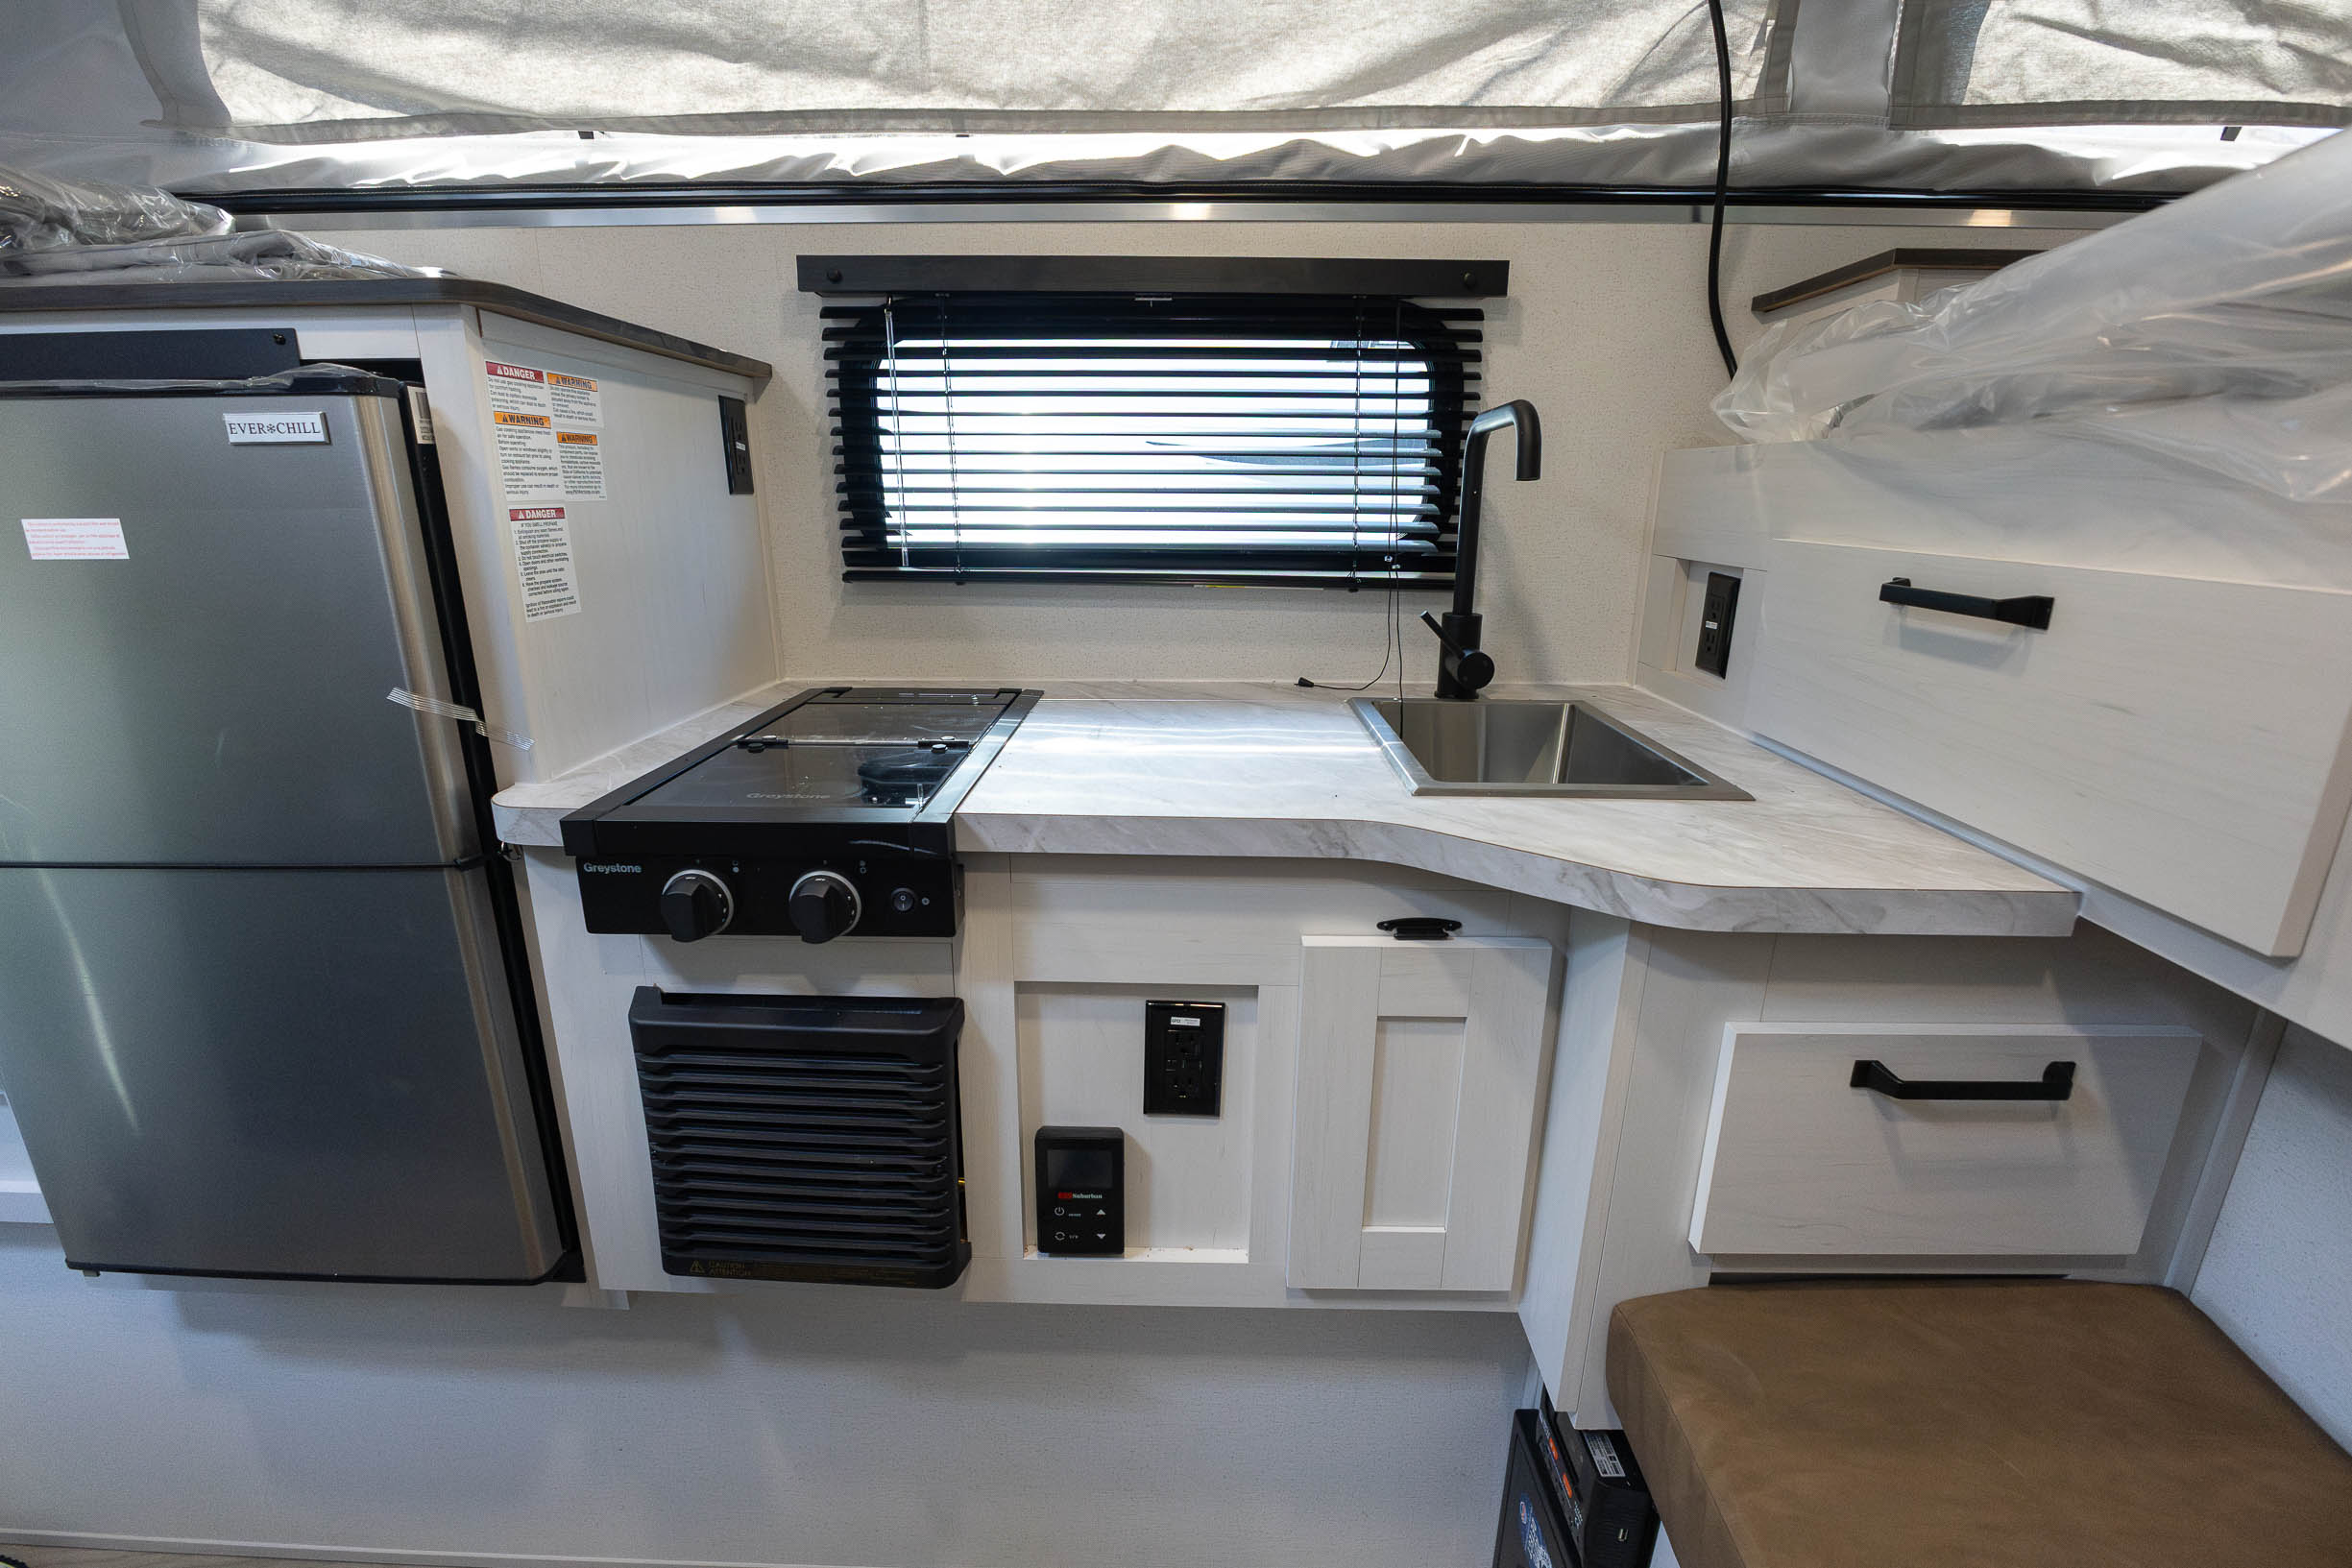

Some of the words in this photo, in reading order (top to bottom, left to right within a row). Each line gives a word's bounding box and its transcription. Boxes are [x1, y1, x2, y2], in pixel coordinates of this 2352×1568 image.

[503, 366, 535, 380] DANGER
[561, 376, 592, 389] WARNING
[508, 415, 545, 425] WARNING
[230, 423, 268, 435] EVER
[276, 422, 322, 435] CHILL
[525, 509, 556, 519] DANGER
[583, 862, 642, 875] Greystone
